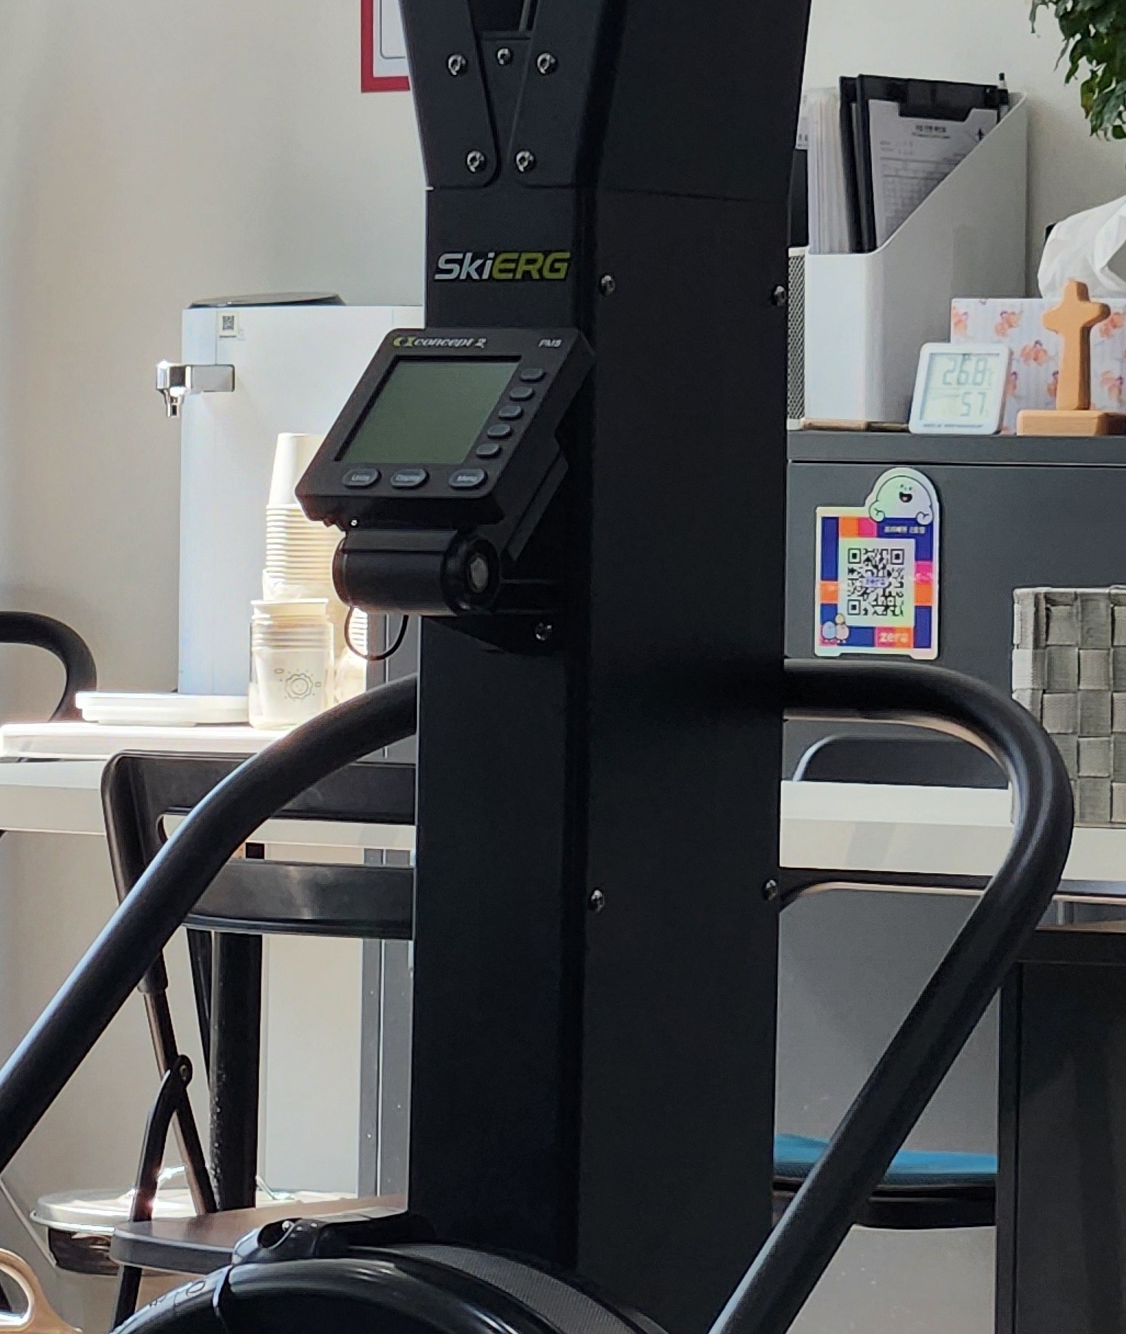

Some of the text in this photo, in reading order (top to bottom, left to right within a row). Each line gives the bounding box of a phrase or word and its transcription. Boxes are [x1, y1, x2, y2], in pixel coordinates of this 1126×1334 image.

[434, 251, 572, 280] SkiERG
[414, 337, 487, 349] concept 2
